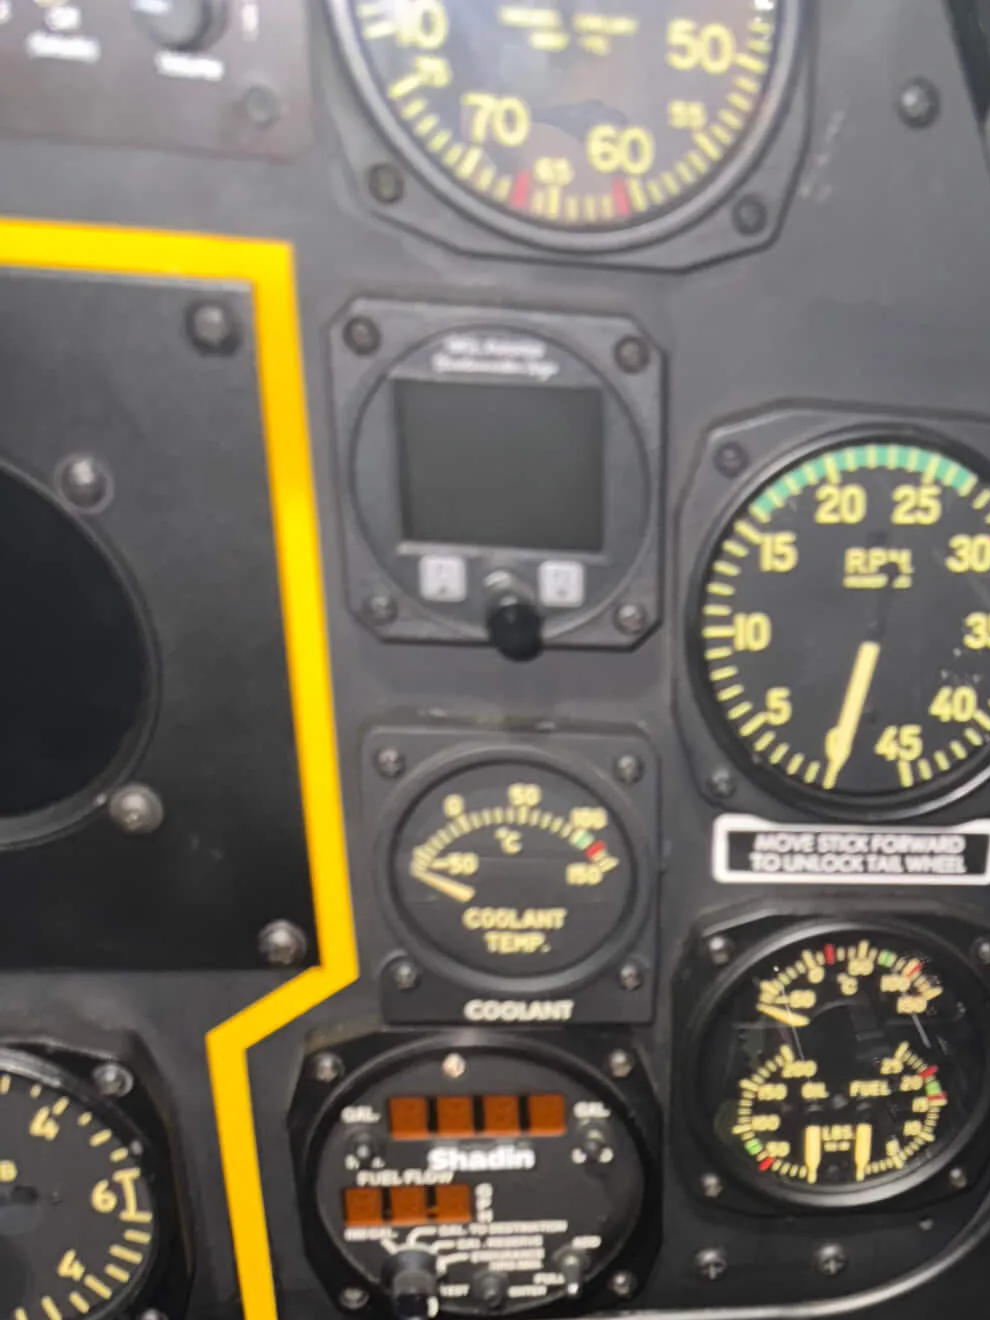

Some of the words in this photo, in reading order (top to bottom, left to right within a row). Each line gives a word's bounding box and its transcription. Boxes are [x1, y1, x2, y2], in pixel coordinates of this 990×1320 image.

[667, 18, 735, 74] 50
[461, 92, 531, 147] 70
[586, 124, 654, 176] 60
[814, 483, 866, 526] 20
[890, 485, 942, 526] 25
[760, 532, 797, 573] 15
[732, 612, 772, 652] 10
[766, 687, 792, 725] 5
[929, 685, 978, 722] 40
[875, 725, 923, 762] 45
[754, 834, 815, 853] MOVE
[816, 834, 868, 853] STICK
[871, 835, 966, 854] FORWARD
[750, 852, 780, 872] TO
[782, 853, 865, 873] UNLOCK
[867, 854, 903, 873] TAIL
[905, 855, 967, 874] WHEEL
[462, 907, 567, 930] COOLANT
[484, 931, 551, 954] TEMP.
[463, 999, 575, 1022] COOLANT
[29, 1106, 59, 1140] 4
[427, 1145, 536, 1171] Shadin
[91, 1179, 117, 1213] 6
[57, 1249, 84, 1281] 4
